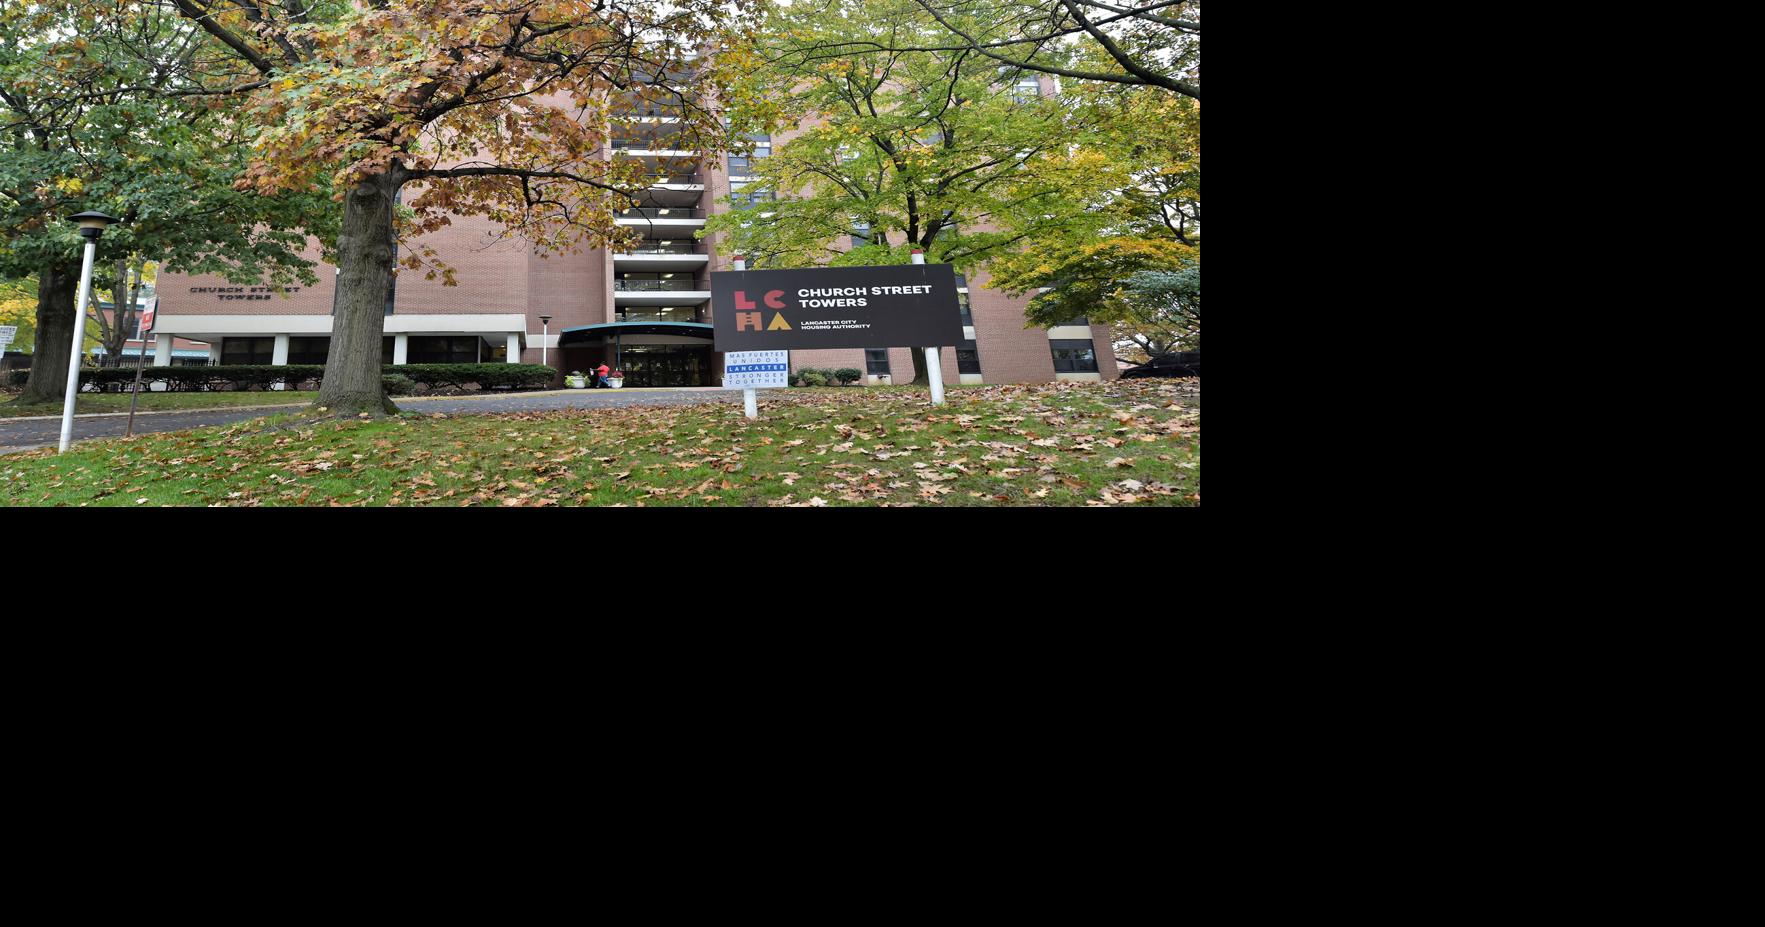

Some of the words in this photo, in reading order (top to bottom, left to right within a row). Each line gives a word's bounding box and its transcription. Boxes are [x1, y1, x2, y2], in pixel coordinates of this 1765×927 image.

[798, 288, 867, 297] CHURCH
[871, 285, 932, 295] STREET
[799, 298, 868, 308] TOWERS
